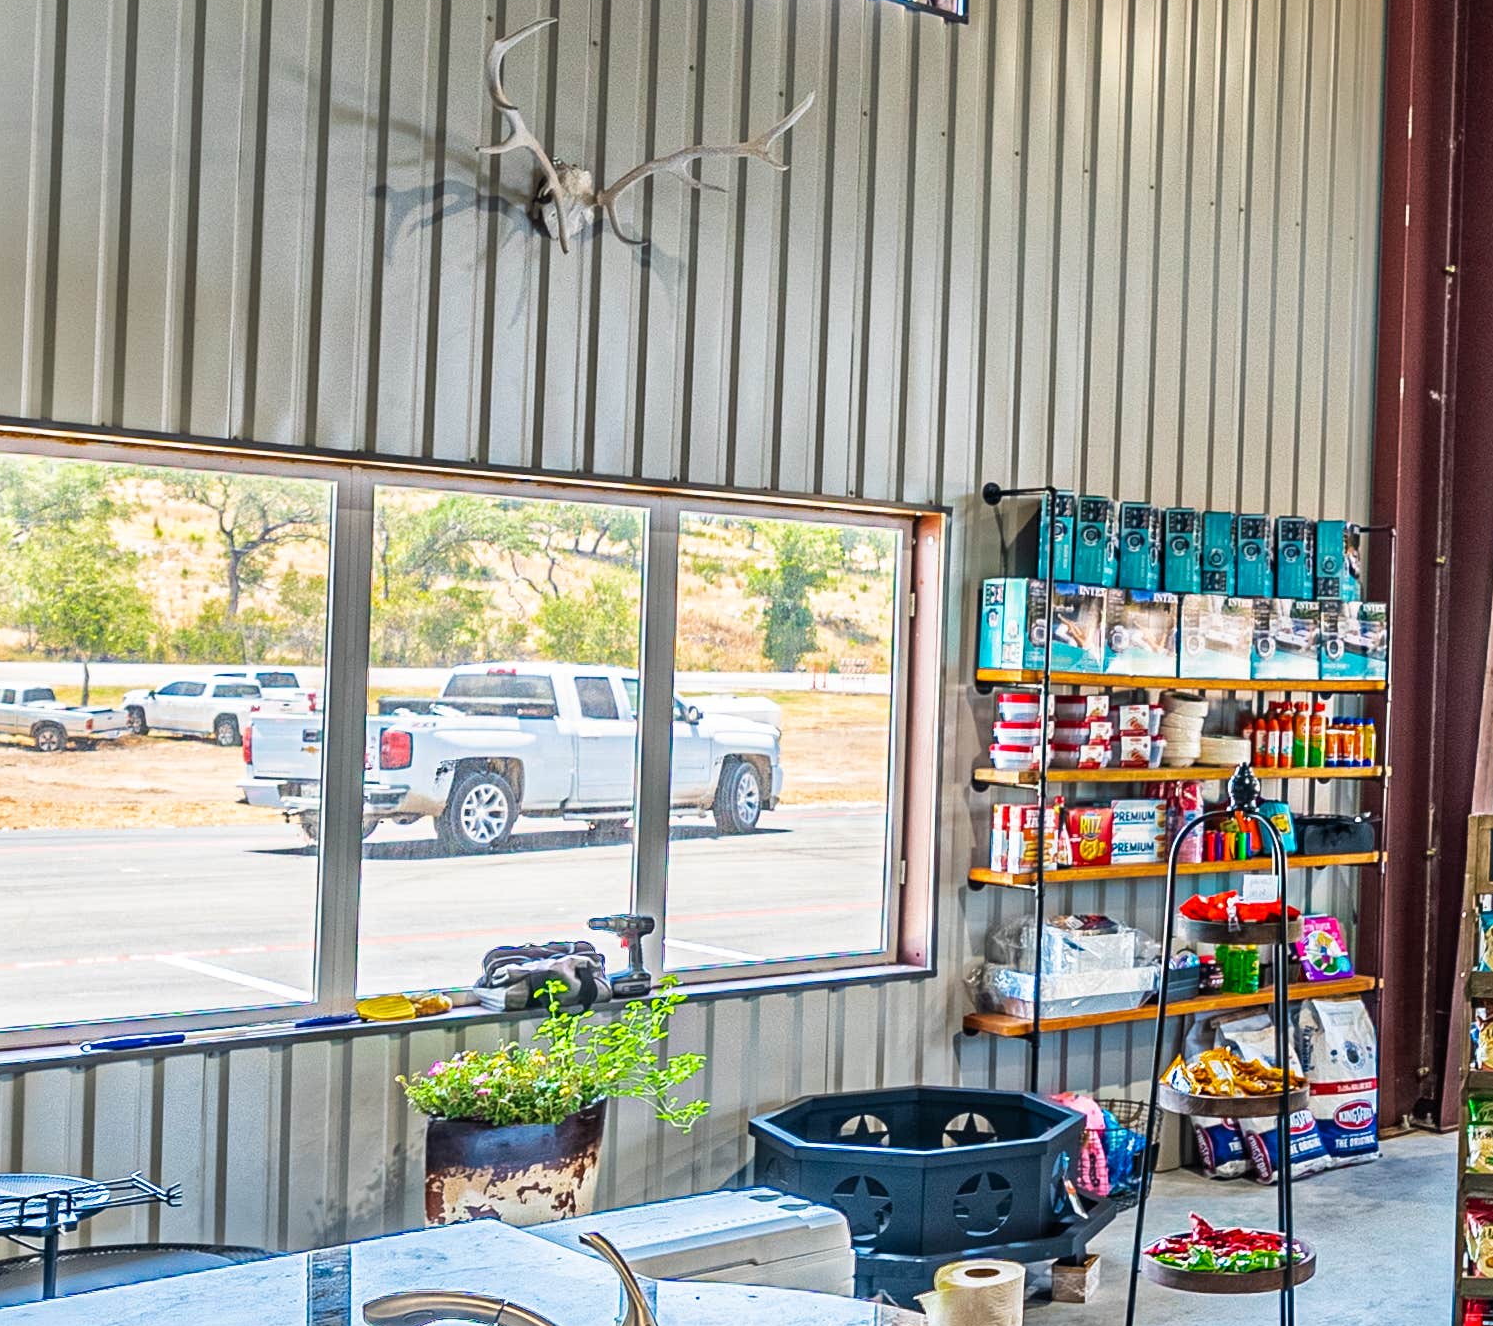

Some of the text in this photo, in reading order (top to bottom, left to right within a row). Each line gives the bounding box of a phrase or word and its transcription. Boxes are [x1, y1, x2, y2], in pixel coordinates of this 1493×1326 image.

[1113, 811, 1155, 823] PREMIUM
[1080, 815, 1101, 833] RITZ
[1112, 842, 1154, 853] PREMIUM
